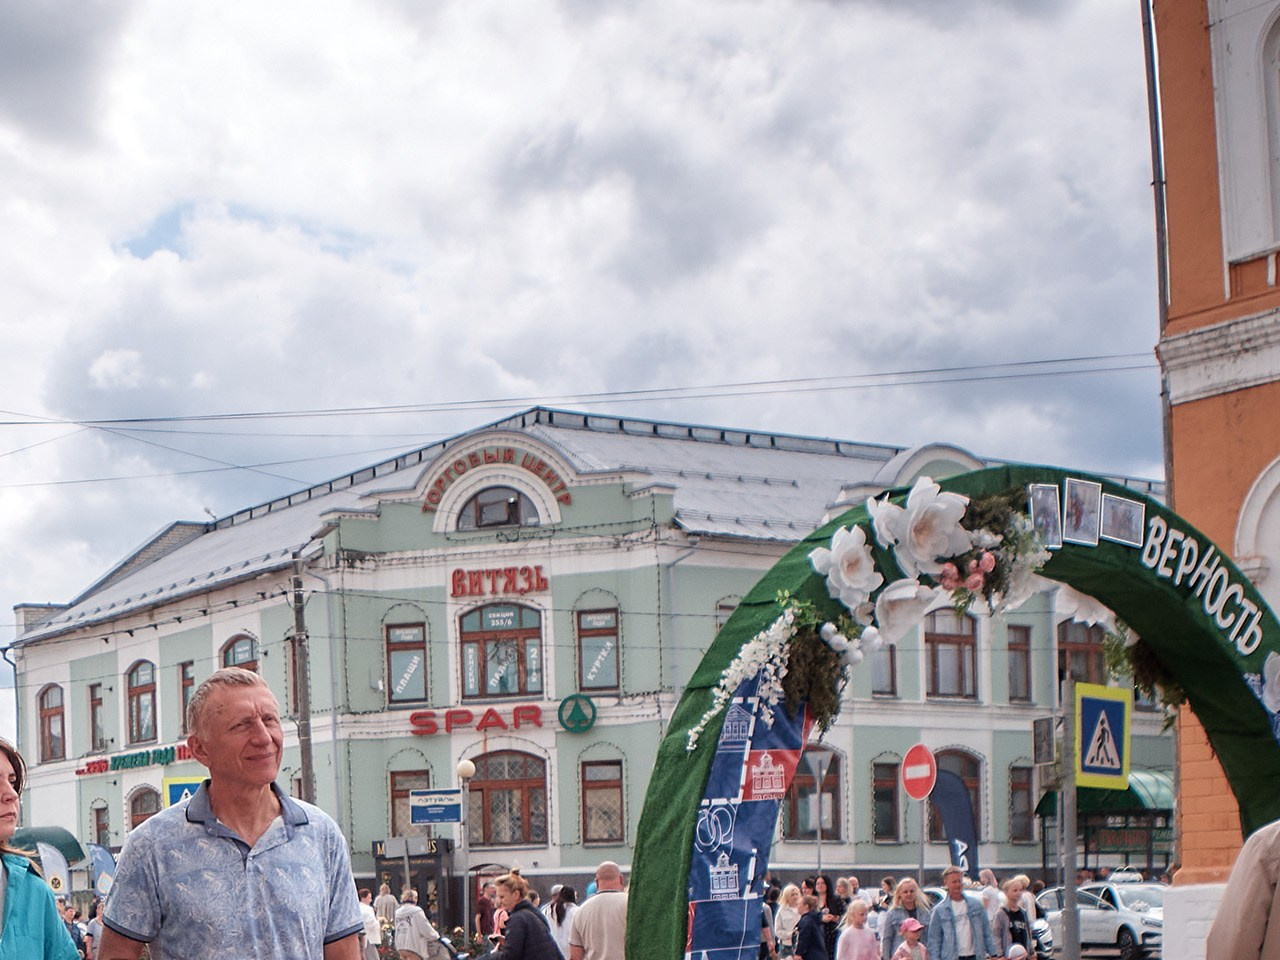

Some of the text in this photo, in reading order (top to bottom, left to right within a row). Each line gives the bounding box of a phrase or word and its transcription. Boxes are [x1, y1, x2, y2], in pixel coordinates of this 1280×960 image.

[422, 447, 573, 513] ТОРГОВЫЙ ЦЕНТР
[451, 565, 549, 597] ВИТЯЗЬ
[1142, 515, 1263, 656] ВЕРНОСТЬ
[395, 655, 421, 694] ПЛАЩИ
[409, 705, 543, 735] SPAR
